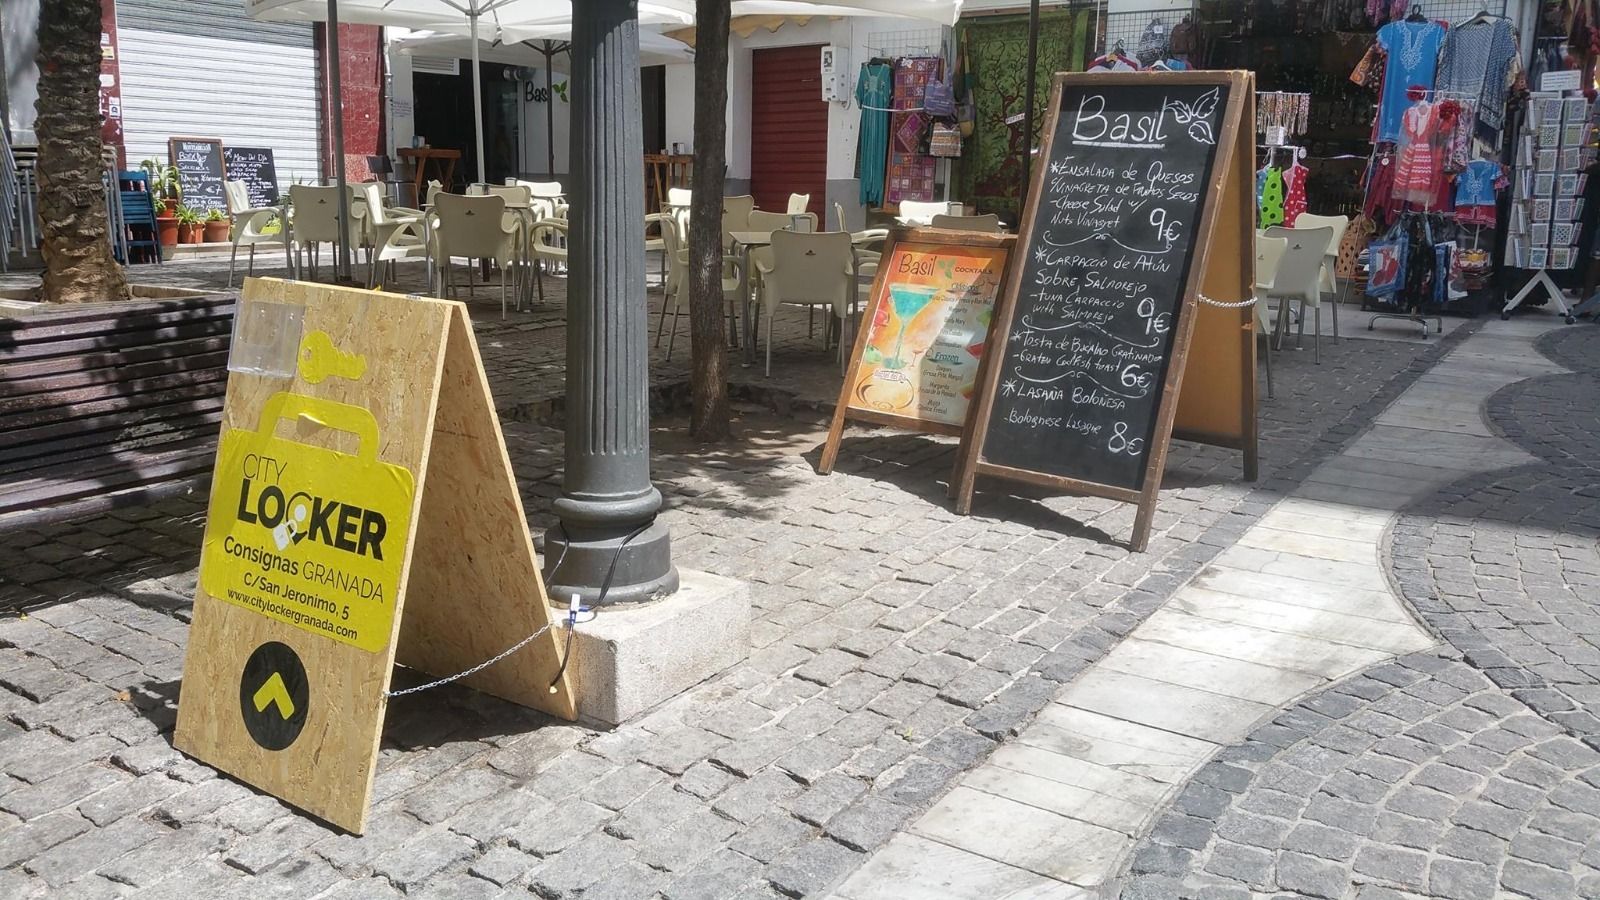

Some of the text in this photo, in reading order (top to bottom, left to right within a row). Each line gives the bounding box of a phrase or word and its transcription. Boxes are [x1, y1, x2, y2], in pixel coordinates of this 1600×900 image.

[1072, 95, 1168, 142] Basil
[1121, 162, 1138, 180] de
[1115, 183, 1128, 196] de
[1150, 207, 1183, 241] 9€
[898, 253, 993, 276] Basil COCKTAILS
[1113, 255, 1130, 269] de
[1137, 297, 1172, 334] 9€
[935, 351, 960, 361] Frozen
[1055, 334, 1070, 350] de
[1121, 364, 1153, 388] 6€
[1108, 422, 1144, 456] 8€
[243, 453, 288, 485] CITY
[237, 478, 387, 561] LOCKER
[224, 535, 384, 603] Consignas GRANADA
[243, 572, 280, 595] C/San
[341, 605, 350, 620] 5
[227, 587, 358, 640] www.citylockergranada.com
